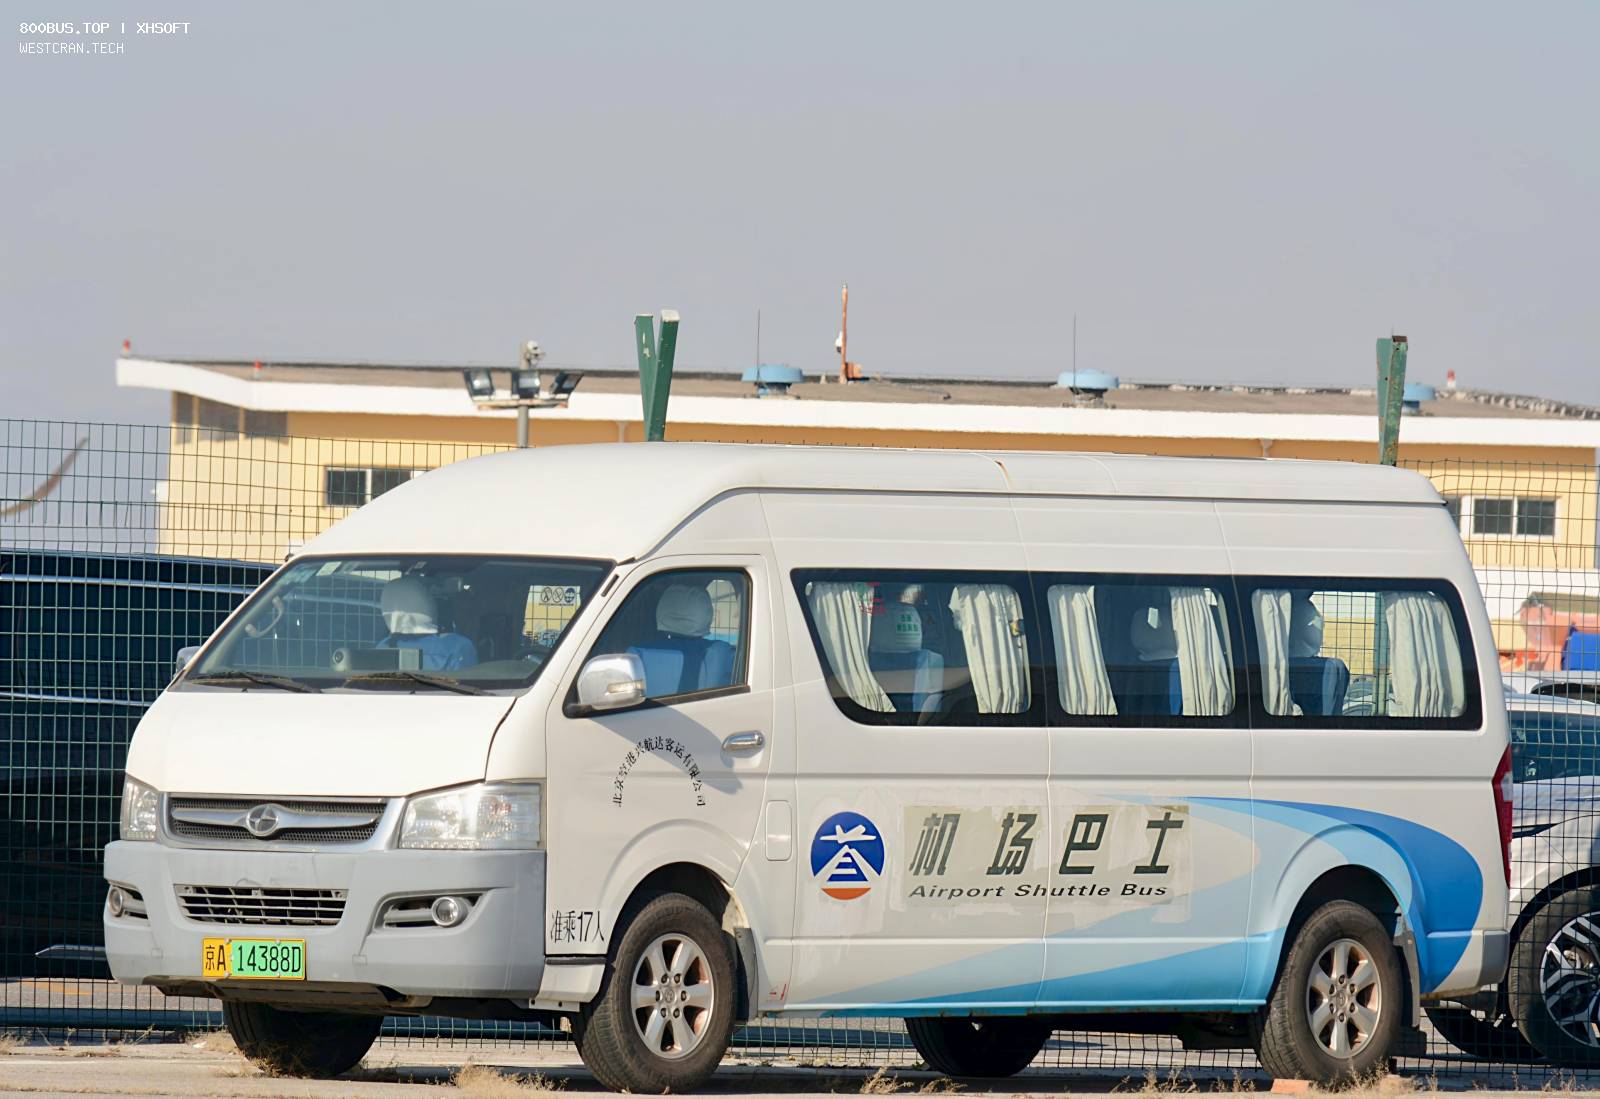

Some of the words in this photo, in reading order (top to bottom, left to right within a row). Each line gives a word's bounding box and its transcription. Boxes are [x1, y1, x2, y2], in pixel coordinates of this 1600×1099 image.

[908, 811, 1185, 876] 机场巴士
[909, 884, 1004, 900] Airport
[1014, 884, 1110, 897] Shuttle
[1121, 884, 1167, 896] Bus
[550, 910, 604, 943] 准乘17人
